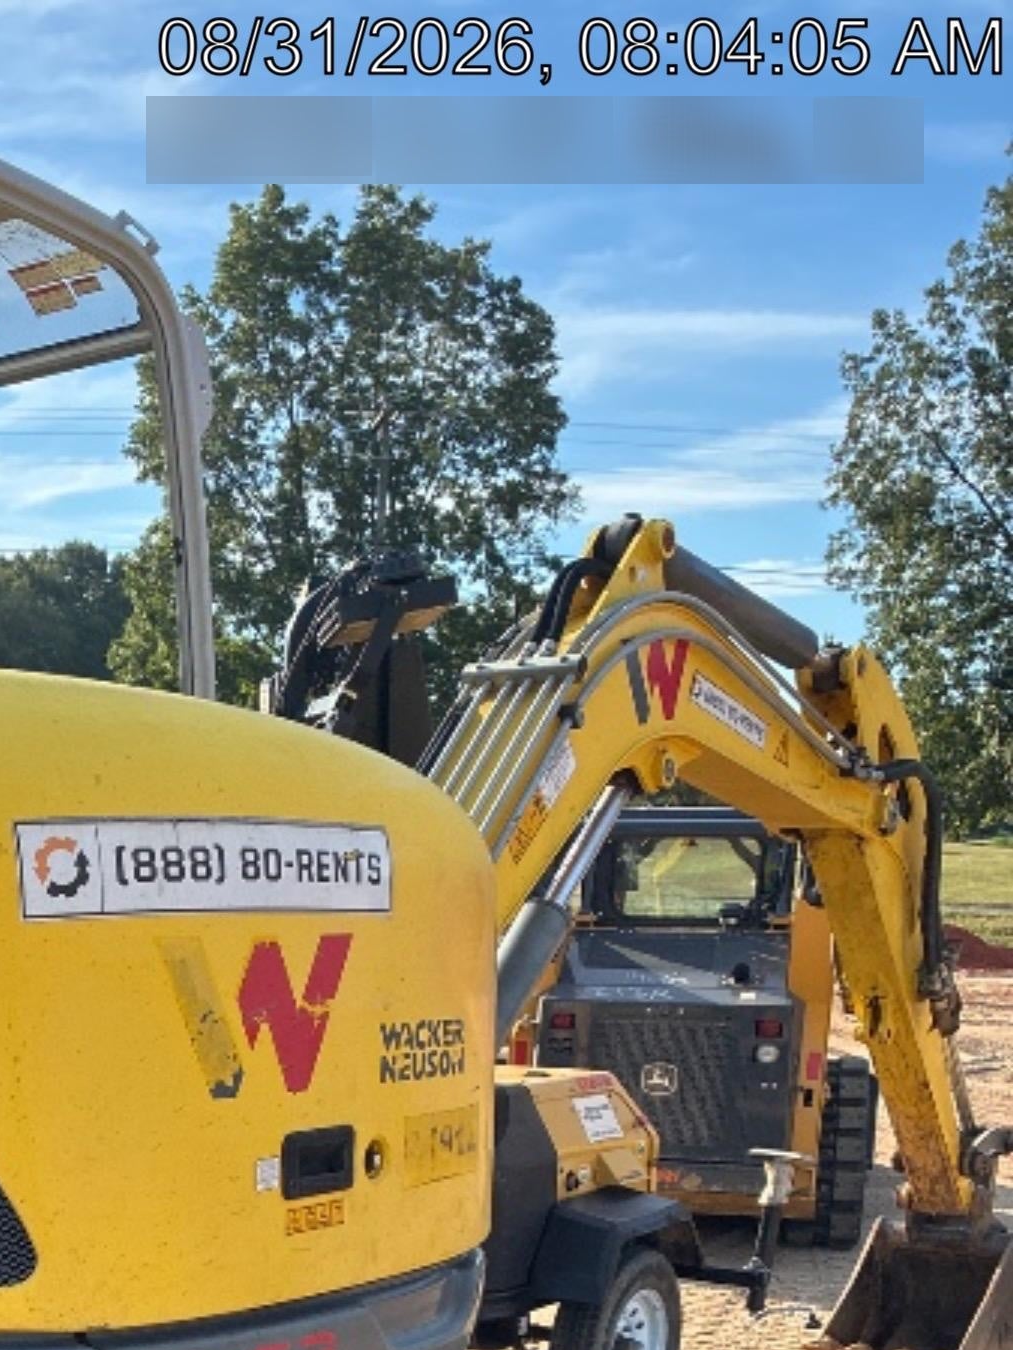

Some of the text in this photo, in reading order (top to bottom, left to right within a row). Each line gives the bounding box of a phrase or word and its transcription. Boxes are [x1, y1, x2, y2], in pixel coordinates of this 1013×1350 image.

[114, 844, 383, 887] (888) 80-RENTS
[379, 1018, 465, 1052] WACKER
[379, 1048, 465, 1084] NEUSON
